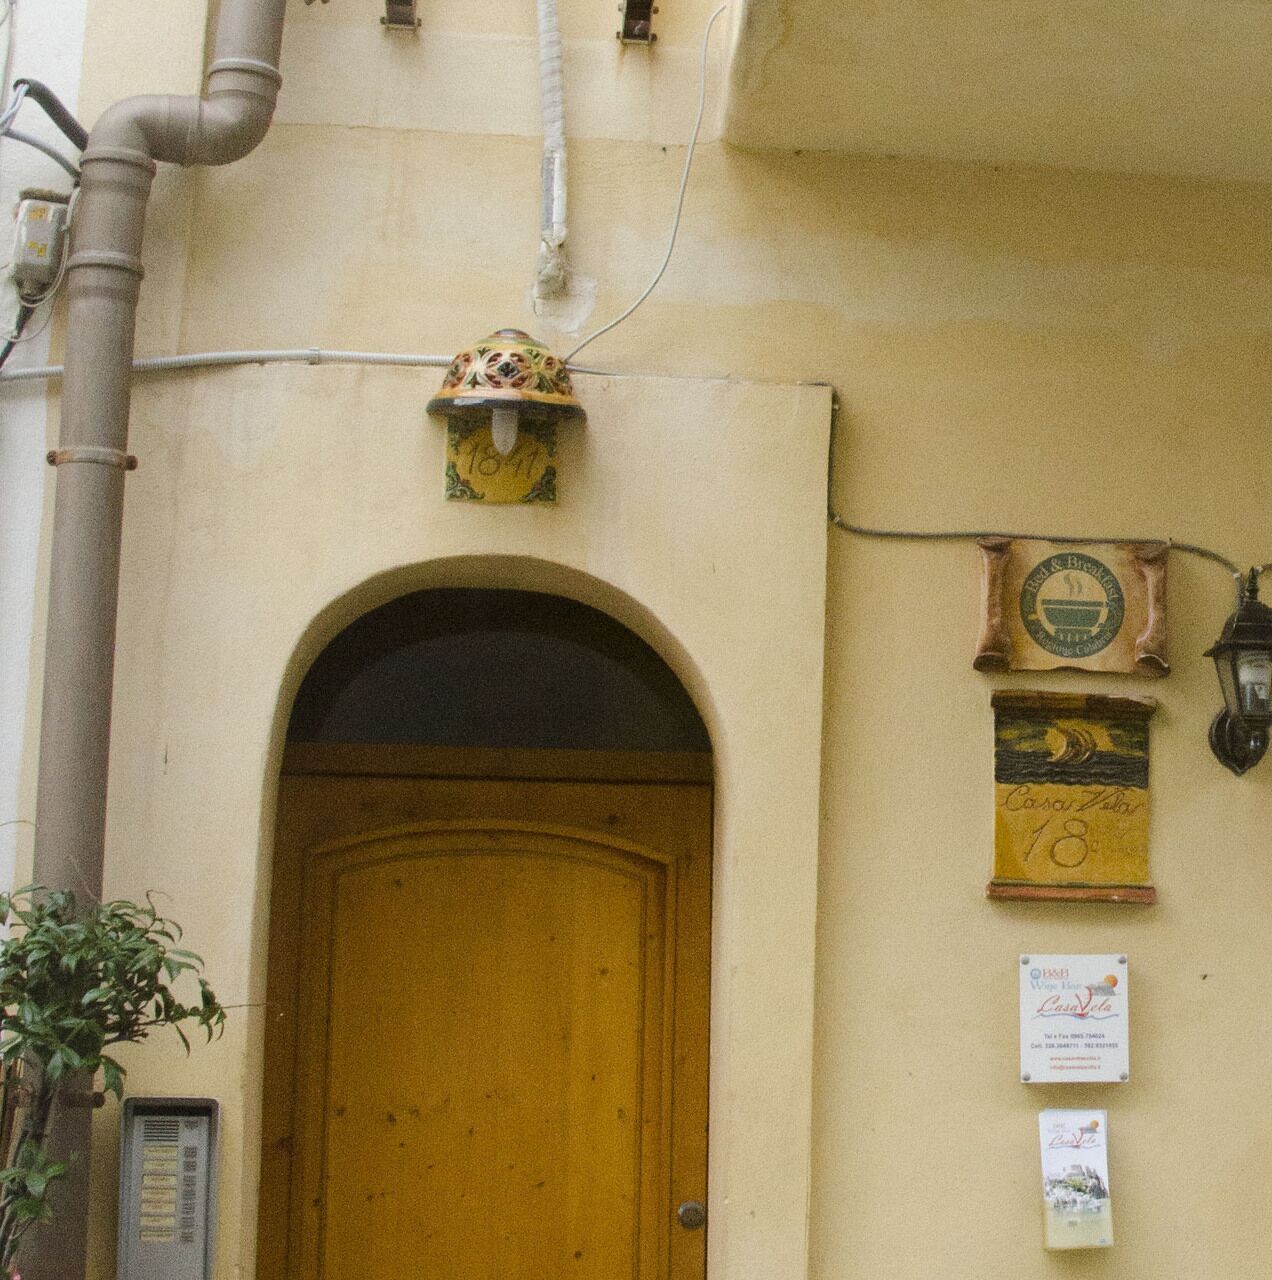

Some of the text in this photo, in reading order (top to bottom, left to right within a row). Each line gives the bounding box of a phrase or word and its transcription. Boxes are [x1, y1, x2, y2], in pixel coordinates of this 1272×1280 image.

[1024, 566, 1050, 594] Bed
[1066, 555, 1120, 601] Breakfast
[1001, 784, 1145, 815] Casa Vela
